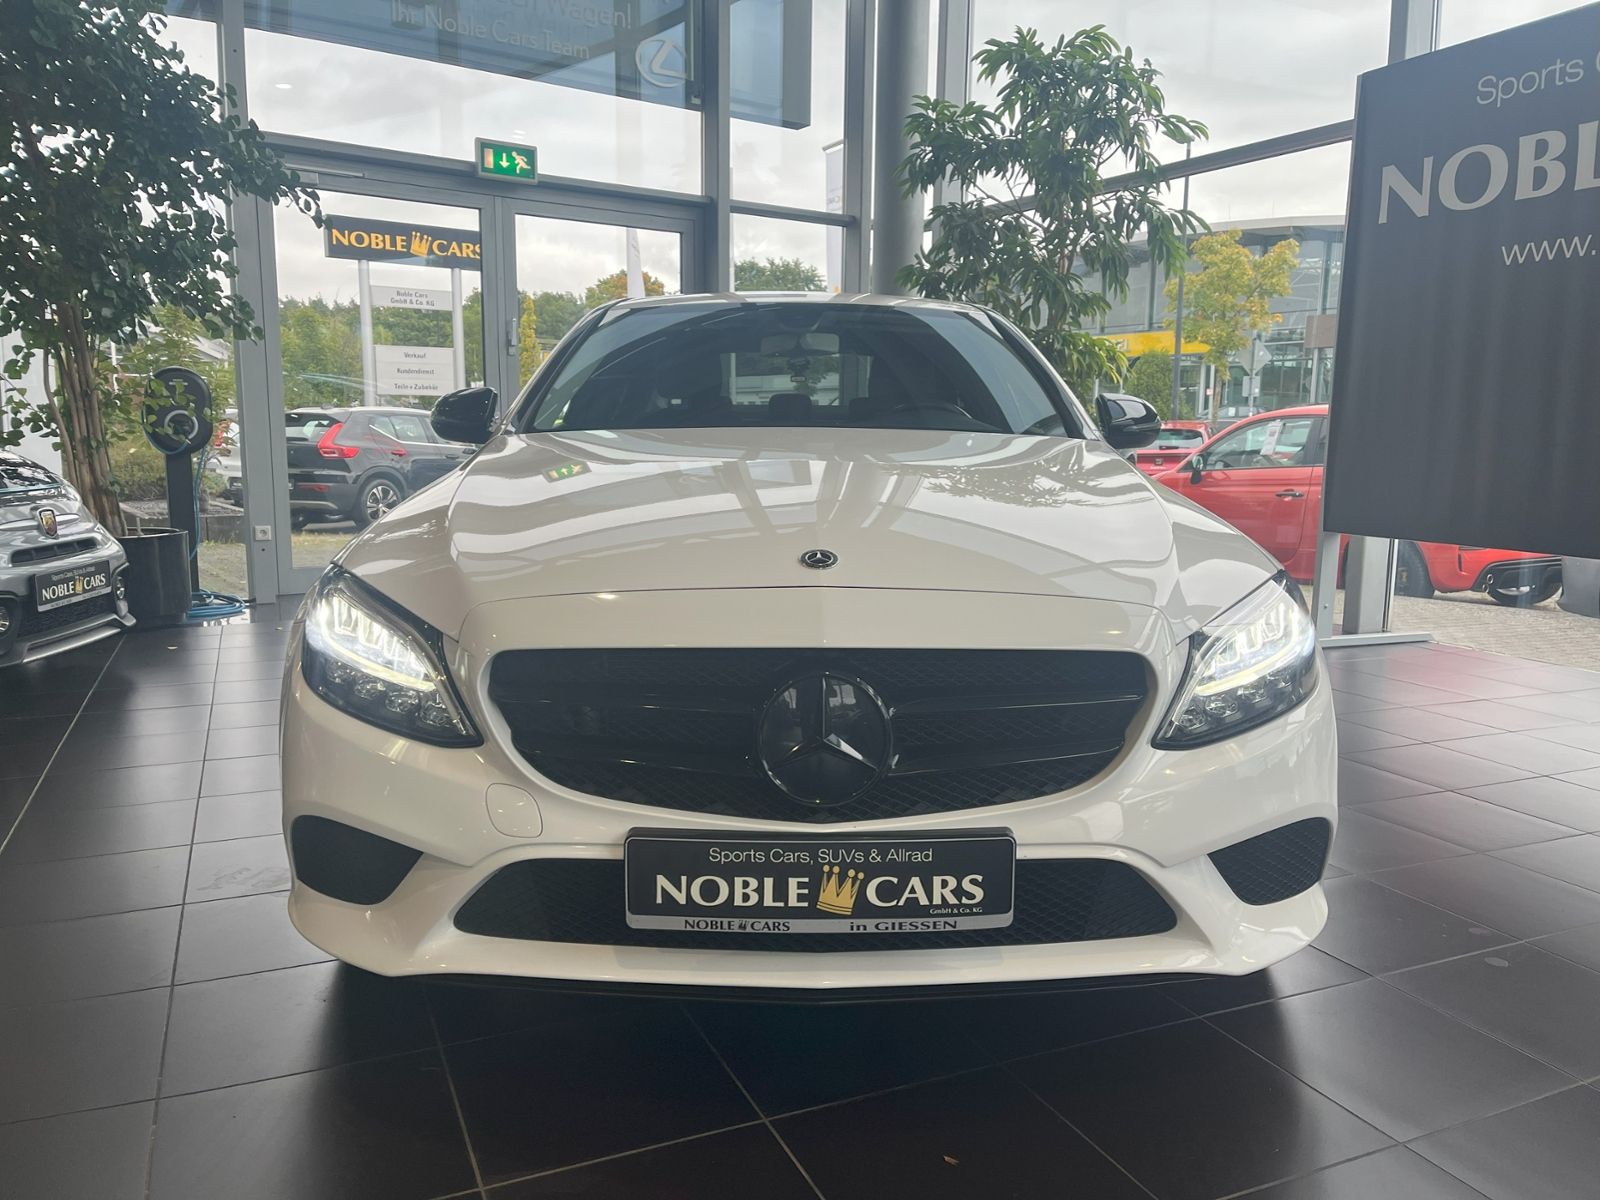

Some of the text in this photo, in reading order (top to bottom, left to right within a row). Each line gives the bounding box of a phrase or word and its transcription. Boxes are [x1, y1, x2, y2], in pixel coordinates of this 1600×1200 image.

[392, 0, 589, 59] Ihr Noble Cars Team
[1476, 58, 1584, 107] Sports
[331, 228, 480, 259] NOBLE CARS
[1502, 234, 1596, 266] www.
[403, 351, 426, 359] Verkauf
[42, 581, 75, 601] NOBLE
[84, 573, 106, 590] CARS
[709, 847, 933, 865] Sports Cars, SUVs & Allrad
[655, 873, 985, 908] NOBLE CARS
[684, 919, 958, 932] NOBLE CARS in GIESSEN
